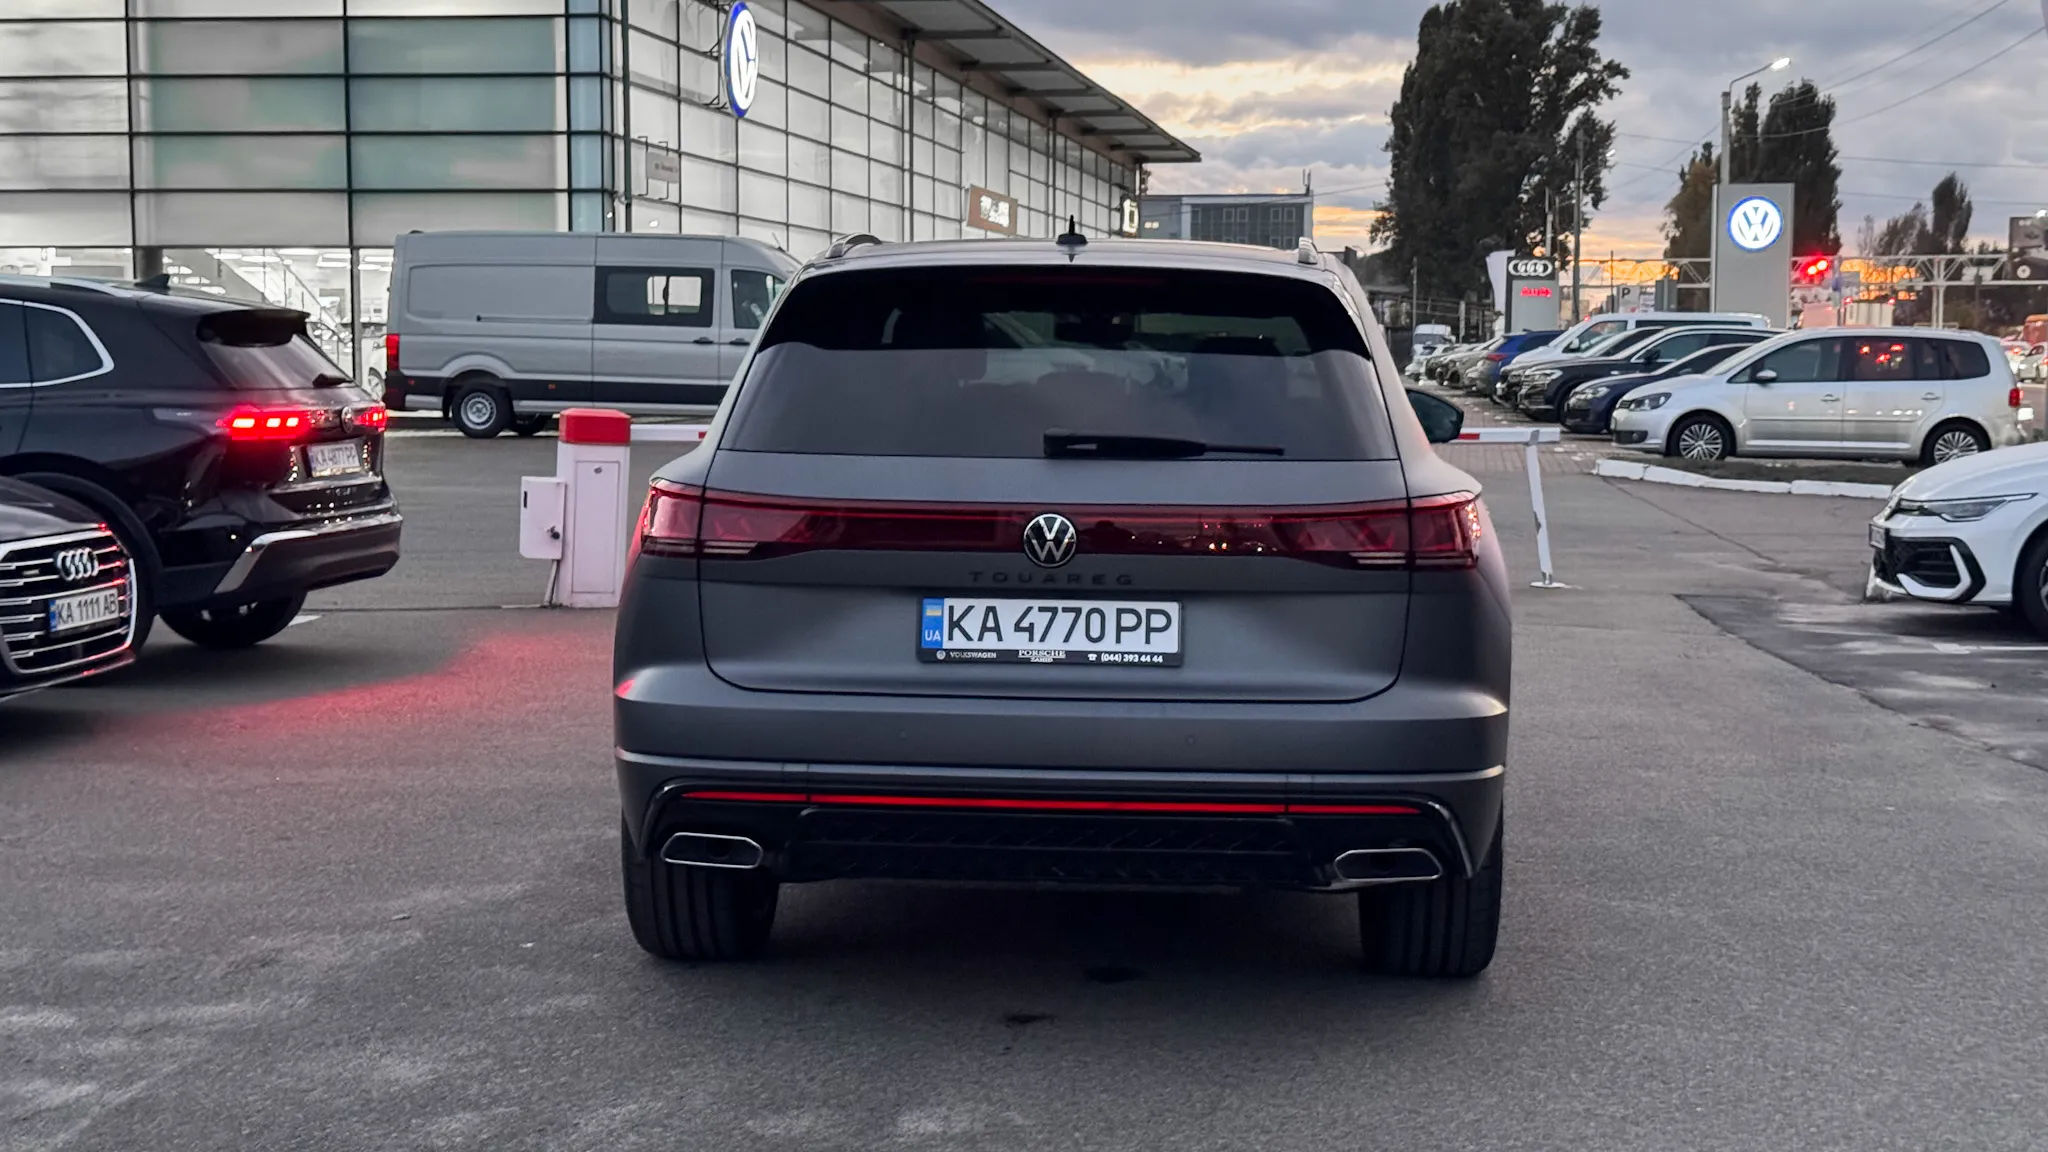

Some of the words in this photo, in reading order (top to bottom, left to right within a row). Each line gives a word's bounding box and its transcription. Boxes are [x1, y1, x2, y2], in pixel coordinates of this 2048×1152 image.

[968, 570, 1133, 586] TOUAREG
[57, 602, 74, 625] KA
[76, 596, 100, 621] 1111
[102, 593, 117, 617] AB
[947, 604, 1004, 642] KA
[1013, 605, 1106, 644] 4770
[1115, 607, 1172, 645] PP
[924, 630, 941, 641] UA
[949, 651, 997, 659] VOLKSWAGEN
[1018, 649, 1066, 657] PORSCHE
[1100, 653, 1122, 663] (044)
[1123, 654, 1139, 663] 393
[1140, 654, 1151, 663] 44
[1152, 655, 1163, 664] 44
